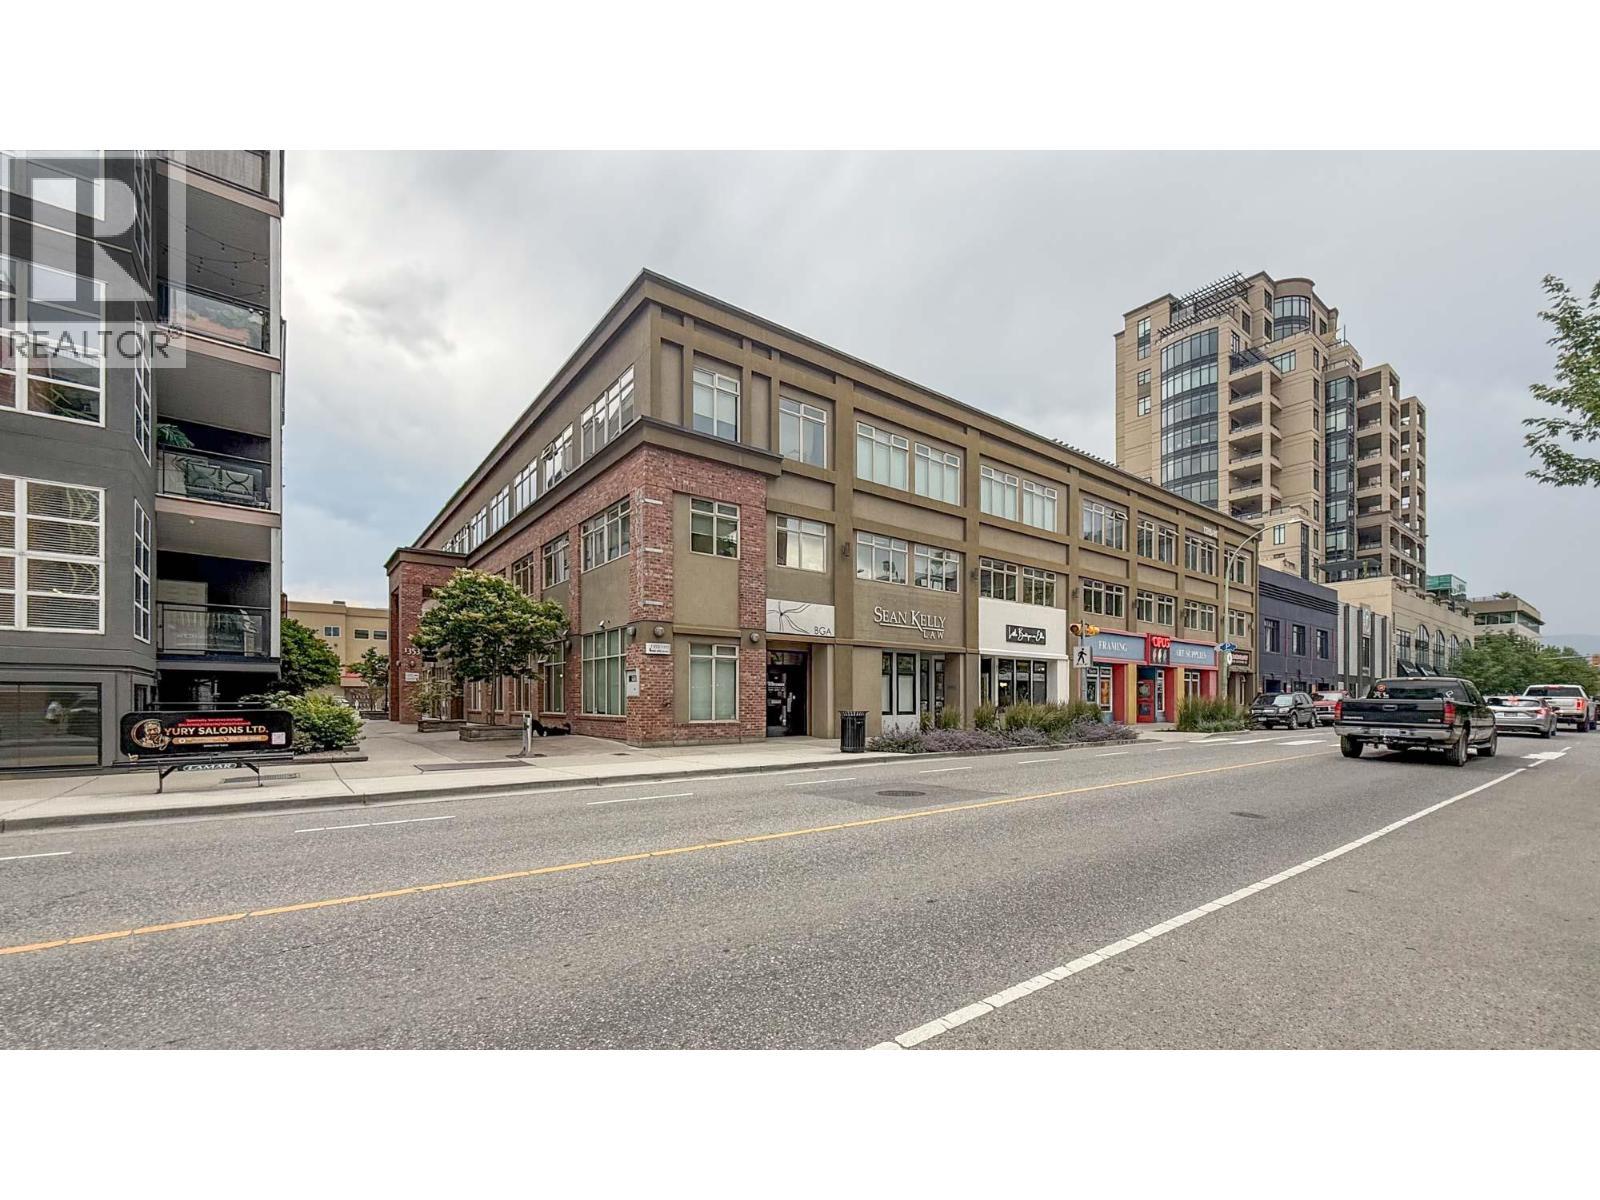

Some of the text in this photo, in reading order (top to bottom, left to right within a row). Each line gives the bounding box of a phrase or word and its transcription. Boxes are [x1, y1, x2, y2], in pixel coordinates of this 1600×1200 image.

[874, 606, 946, 631] SEAN KELLY
[814, 626, 832, 636] BGA
[923, 630, 945, 640] LAW
[404, 647, 420, 655] 1353
[1098, 640, 1128, 652] FRAMING
[164, 727, 196, 736] YURY
[198, 726, 244, 735] SALONS
[246, 725, 269, 734] LTD.
[188, 763, 233, 771] LAMAR
